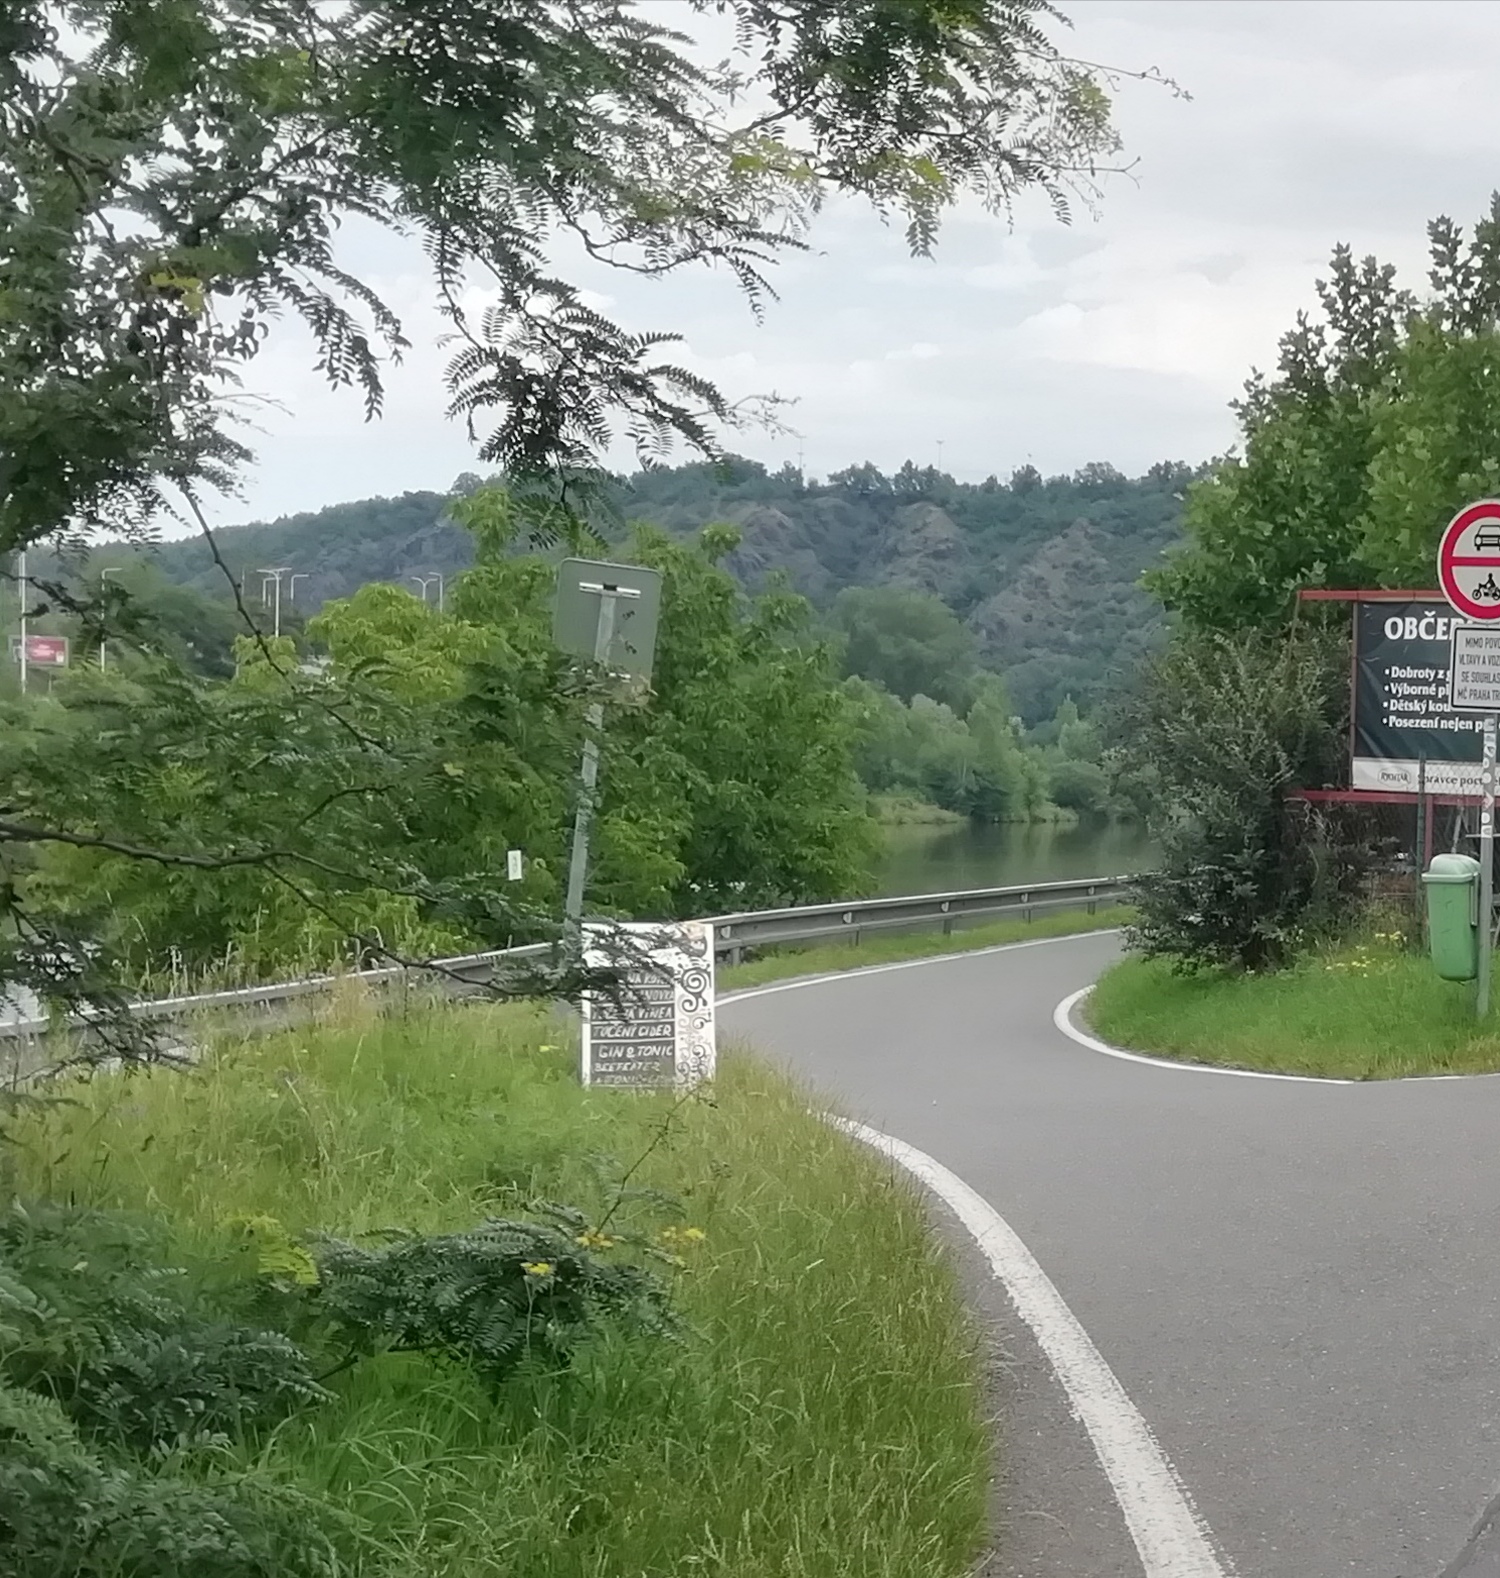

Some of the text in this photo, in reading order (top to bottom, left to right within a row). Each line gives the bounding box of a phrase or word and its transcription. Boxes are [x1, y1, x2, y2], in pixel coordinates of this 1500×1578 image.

[1465, 637, 1483, 649] MIMO
[1459, 654, 1481, 666] VLTAVY
[1482, 655, 1487, 666] A
[1391, 666, 1436, 682] Dobroty
[1437, 670, 1445, 679] z
[1461, 671, 1470, 683] SE
[1389, 682, 1436, 697] Výborné
[1457, 687, 1468, 700] MČ
[1469, 689, 1491, 701] PRAHA
[1389, 698, 1428, 714] Dětský
[1388, 714, 1440, 729] Posezení
[1440, 716, 1473, 733] nejen
[638, 1024, 672, 1038] CIDER
[598, 1045, 625, 1059] GIN
[637, 1045, 674, 1057] TONIC
